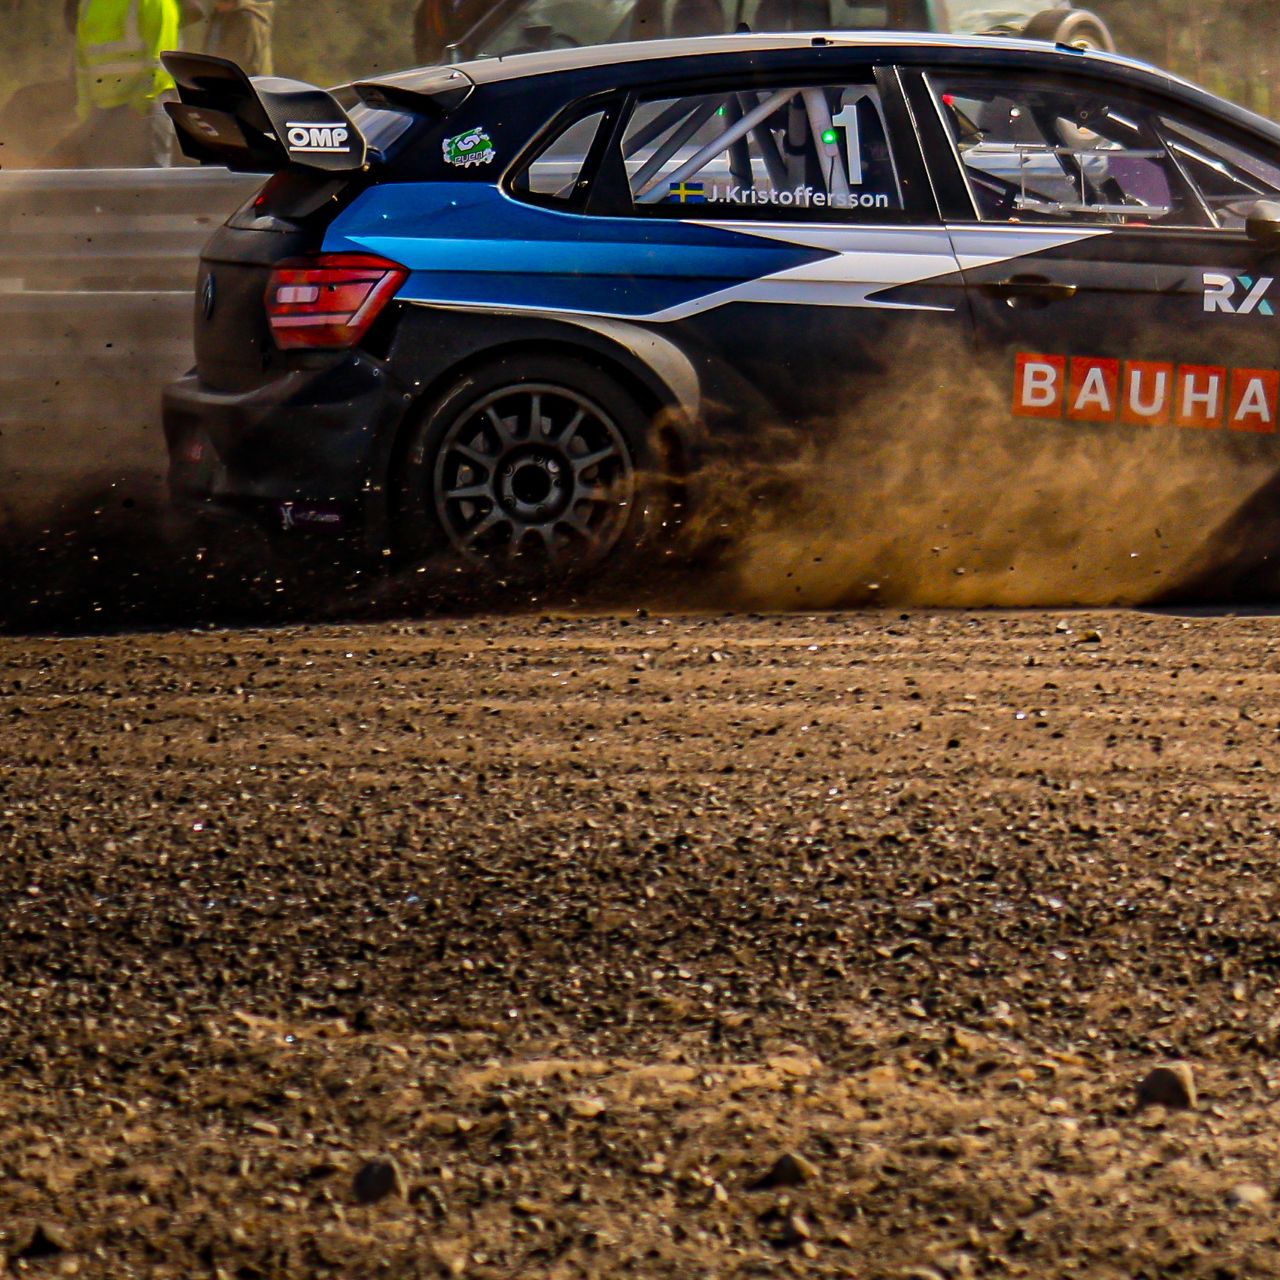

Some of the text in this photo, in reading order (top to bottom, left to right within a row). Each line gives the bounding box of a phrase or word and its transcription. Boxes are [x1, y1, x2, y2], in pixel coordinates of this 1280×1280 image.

[287, 127, 348, 147] OMP
[832, 104, 863, 185] 1
[707, 184, 889, 209] J.Kristoffersson
[1202, 273, 1275, 316] RX
